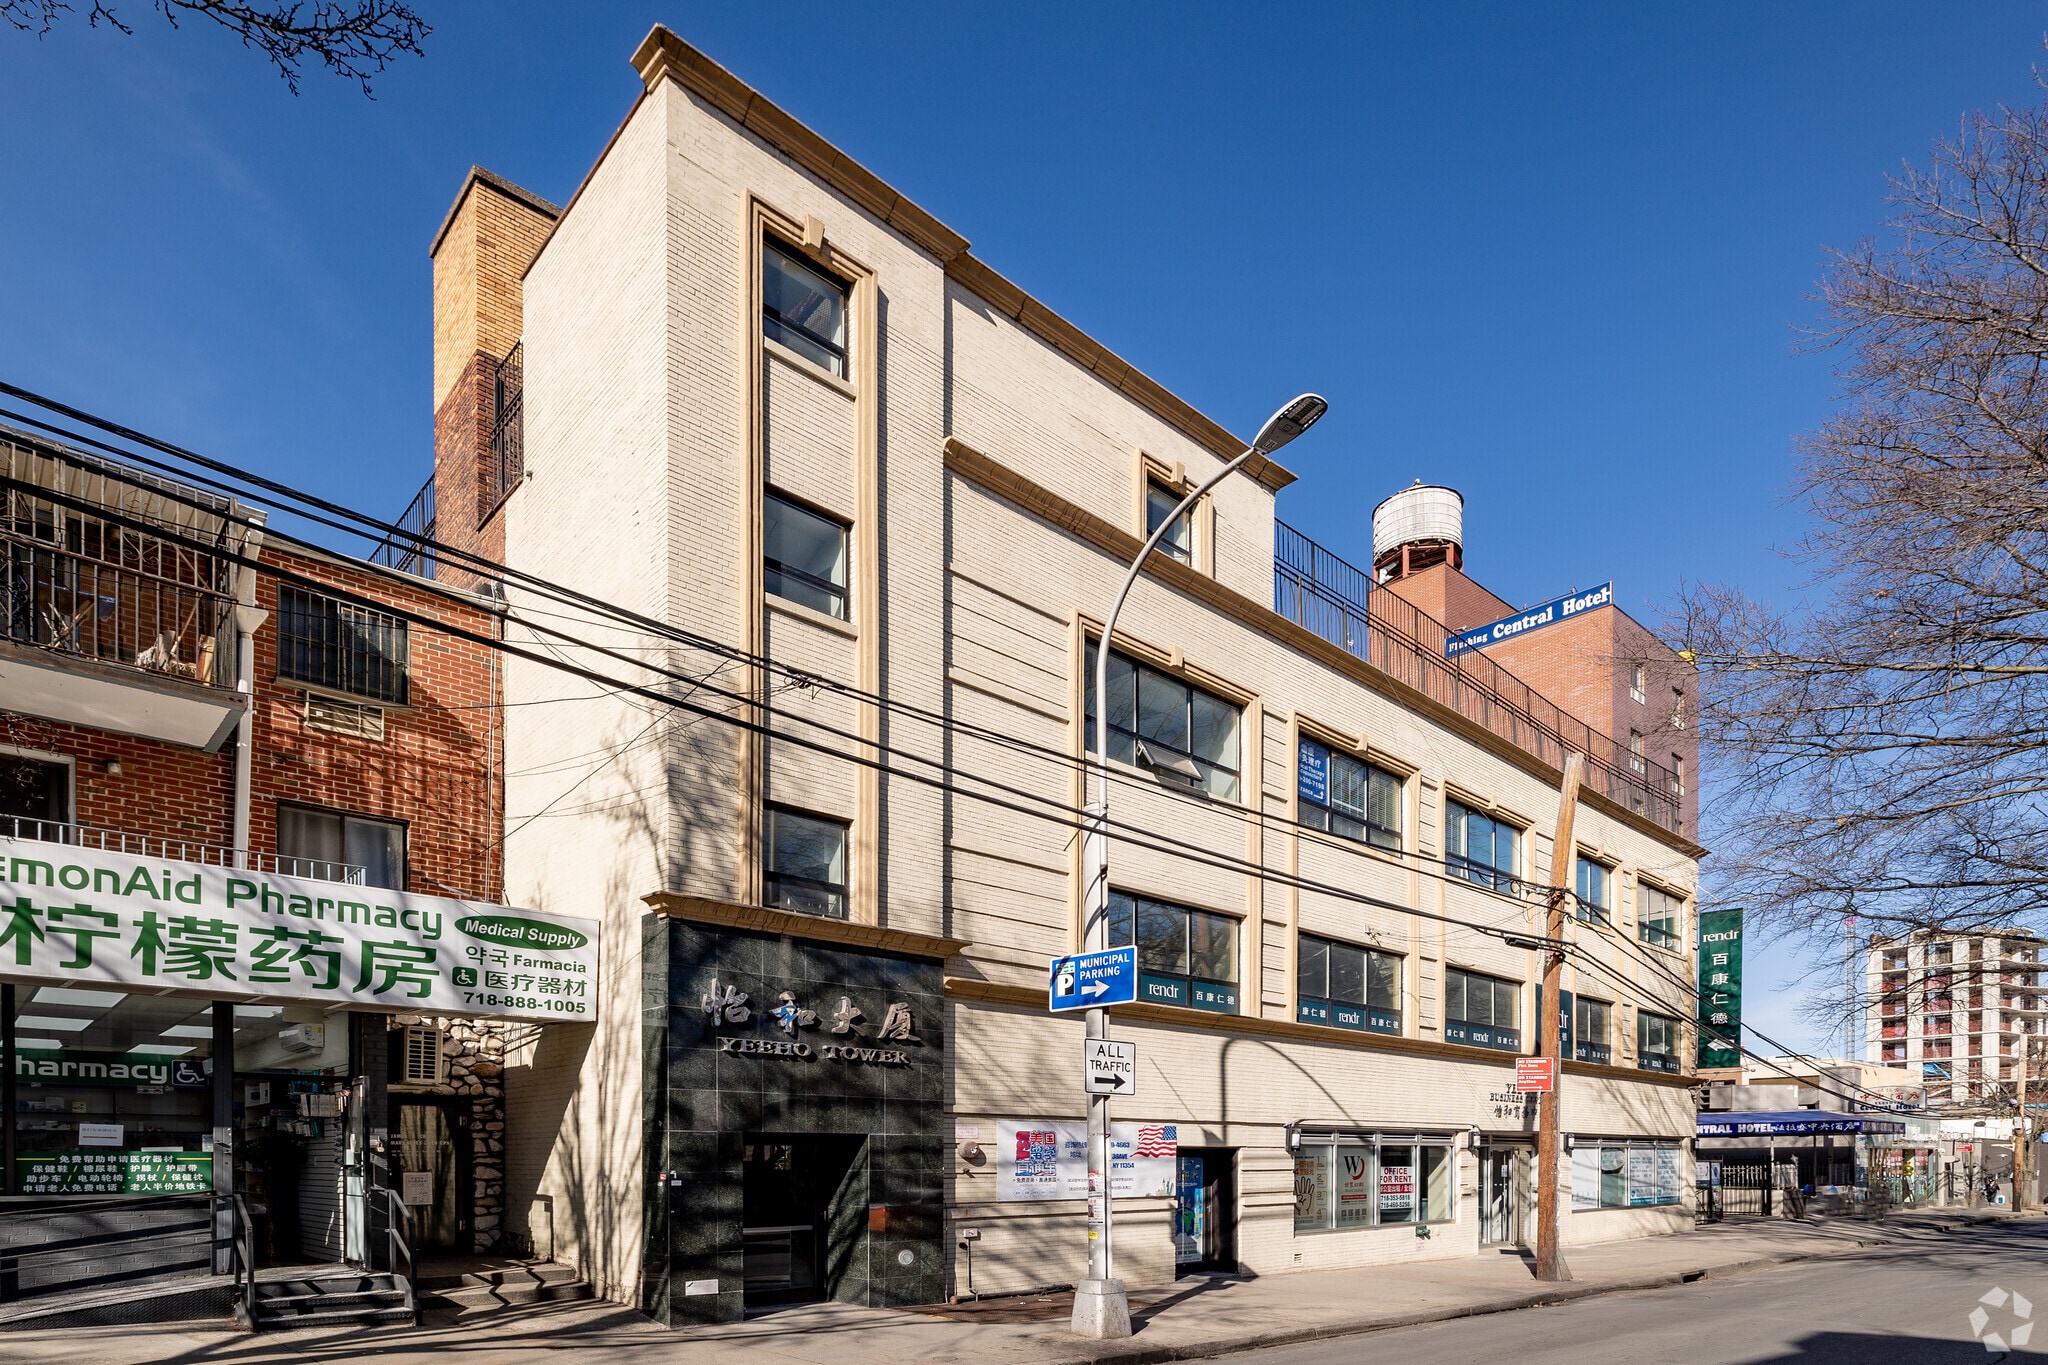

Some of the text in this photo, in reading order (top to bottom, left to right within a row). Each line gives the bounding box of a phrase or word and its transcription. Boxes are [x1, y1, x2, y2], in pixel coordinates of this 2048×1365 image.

[1493, 606, 1553, 638] Central
[1562, 586, 1612, 617] Hotel
[226, 878, 442, 940] Pharmacy
[465, 919, 580, 949] Medical Supply
[1703, 930, 1739, 942] rendr
[0, 896, 440, 999] 柠檬药房
[466, 946, 586, 973] 약국 Farmacia
[1080, 953, 1130, 970] MUNICIPAL
[1080, 966, 1121, 980] PARKING
[485, 971, 587, 997] 医疗器材
[1148, 983, 1179, 998] rendr
[1710, 953, 1729, 1025] 百康仁德
[464, 992, 586, 1014] 718-888-1005
[1196, 990, 1235, 1005] 百康仁德
[1297, 1006, 1327, 1018] 康仁德
[1338, 1012, 1360, 1025] rendr
[1371, 1017, 1399, 1029] 百康仁德
[717, 1037, 910, 1065] YEEHO TOWER
[1096, 1044, 1124, 1059] ALL
[0, 1055, 168, 1084] harmacy
[1089, 1060, 1131, 1073] TRAFFIC
[1738, 1123, 1774, 1134] HOTEL
[1031, 1131, 1056, 1145] 美国
[59, 1155, 174, 1163] 免费帮助申请医疗器材
